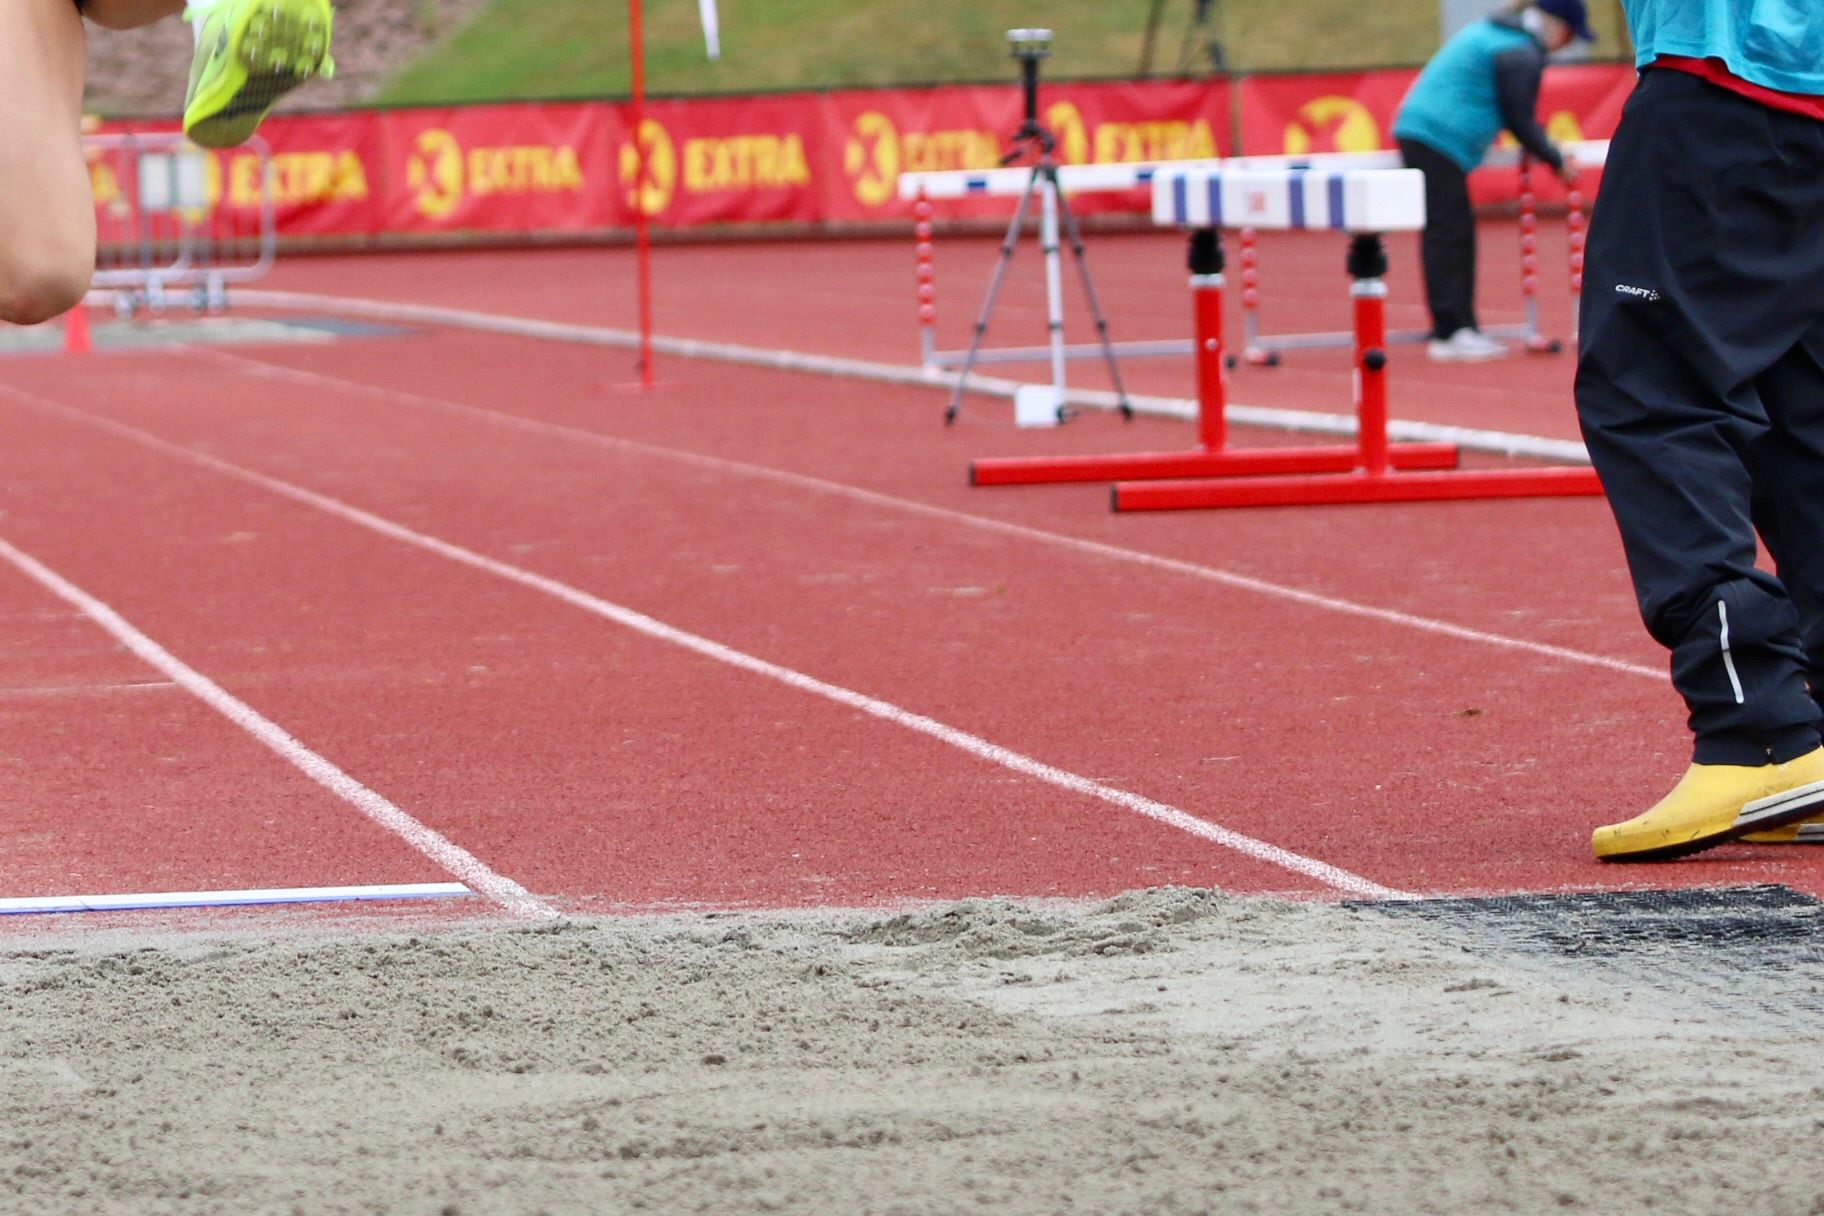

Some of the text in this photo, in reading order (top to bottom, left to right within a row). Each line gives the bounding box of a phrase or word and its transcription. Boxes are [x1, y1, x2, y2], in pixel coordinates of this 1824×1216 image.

[684, 134, 812, 191] EXTRA
[1097, 118, 1218, 165] EXTRA
[229, 151, 369, 206] EXTRA
[468, 145, 583, 195] EXTRA
[1615, 284, 1650, 298] CRAFT
